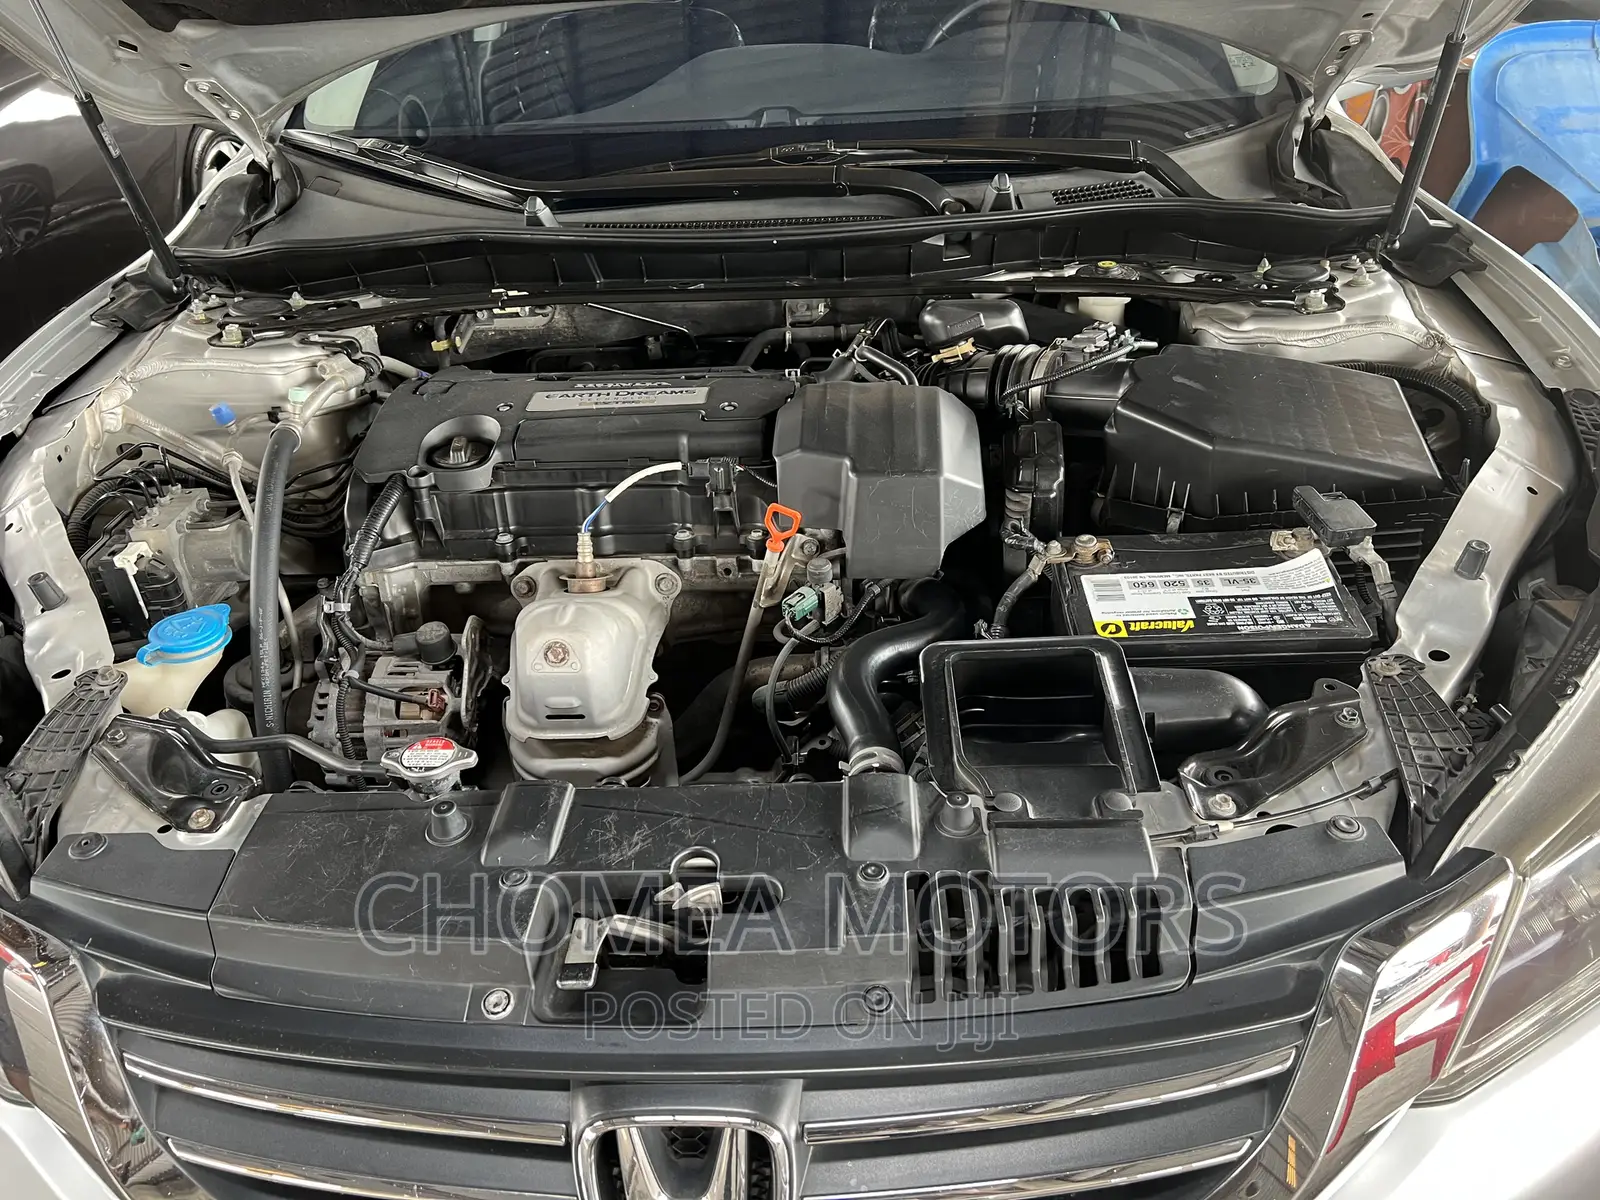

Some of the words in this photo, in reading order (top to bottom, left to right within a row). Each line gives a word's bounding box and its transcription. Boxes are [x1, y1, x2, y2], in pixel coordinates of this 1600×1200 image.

[545, 390, 610, 399] EARTH
[615, 388, 698, 398] DREAMS
[1224, 577, 1256, 585] 35-VL
[1128, 620, 1194, 632] Valucraft
